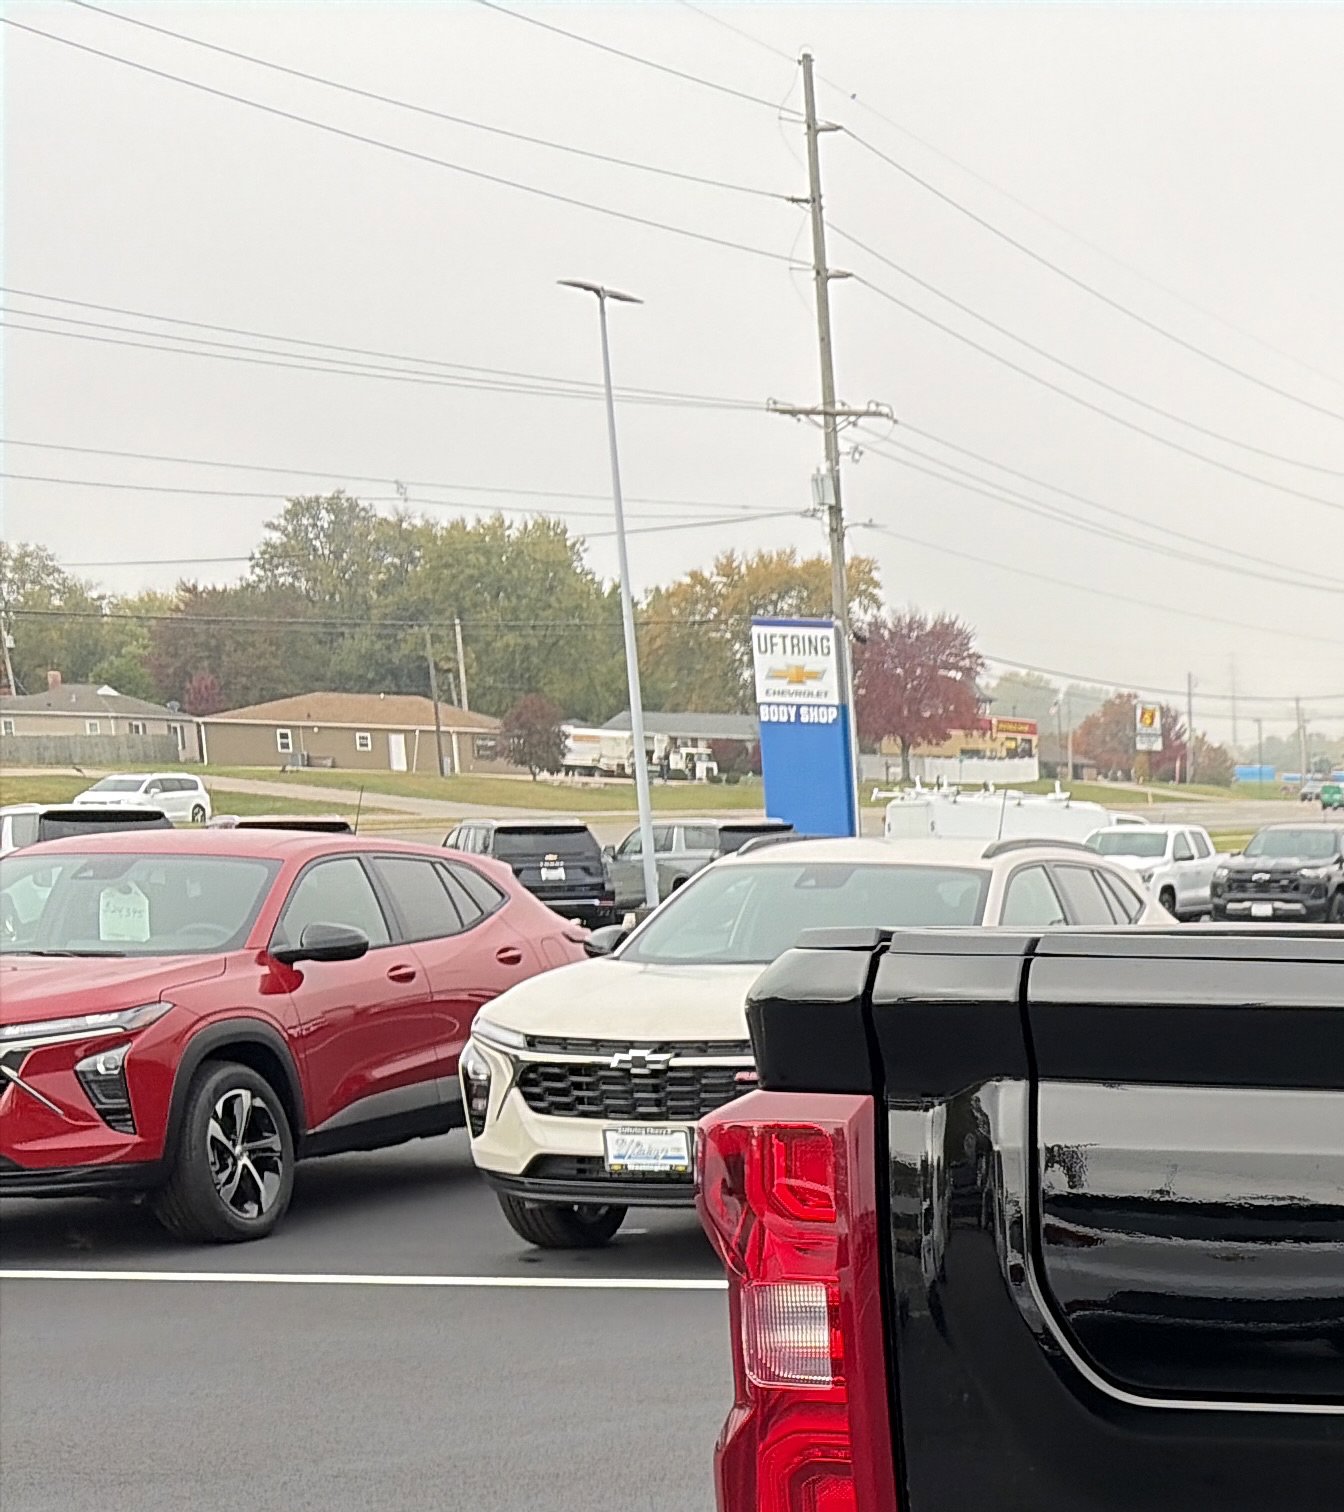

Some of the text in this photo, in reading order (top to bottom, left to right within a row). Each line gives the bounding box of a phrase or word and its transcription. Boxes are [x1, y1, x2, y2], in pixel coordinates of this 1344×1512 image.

[757, 632, 831, 657] UFTRING
[764, 687, 829, 698] CHEVROLET
[759, 704, 837, 724] BODY SHOP
